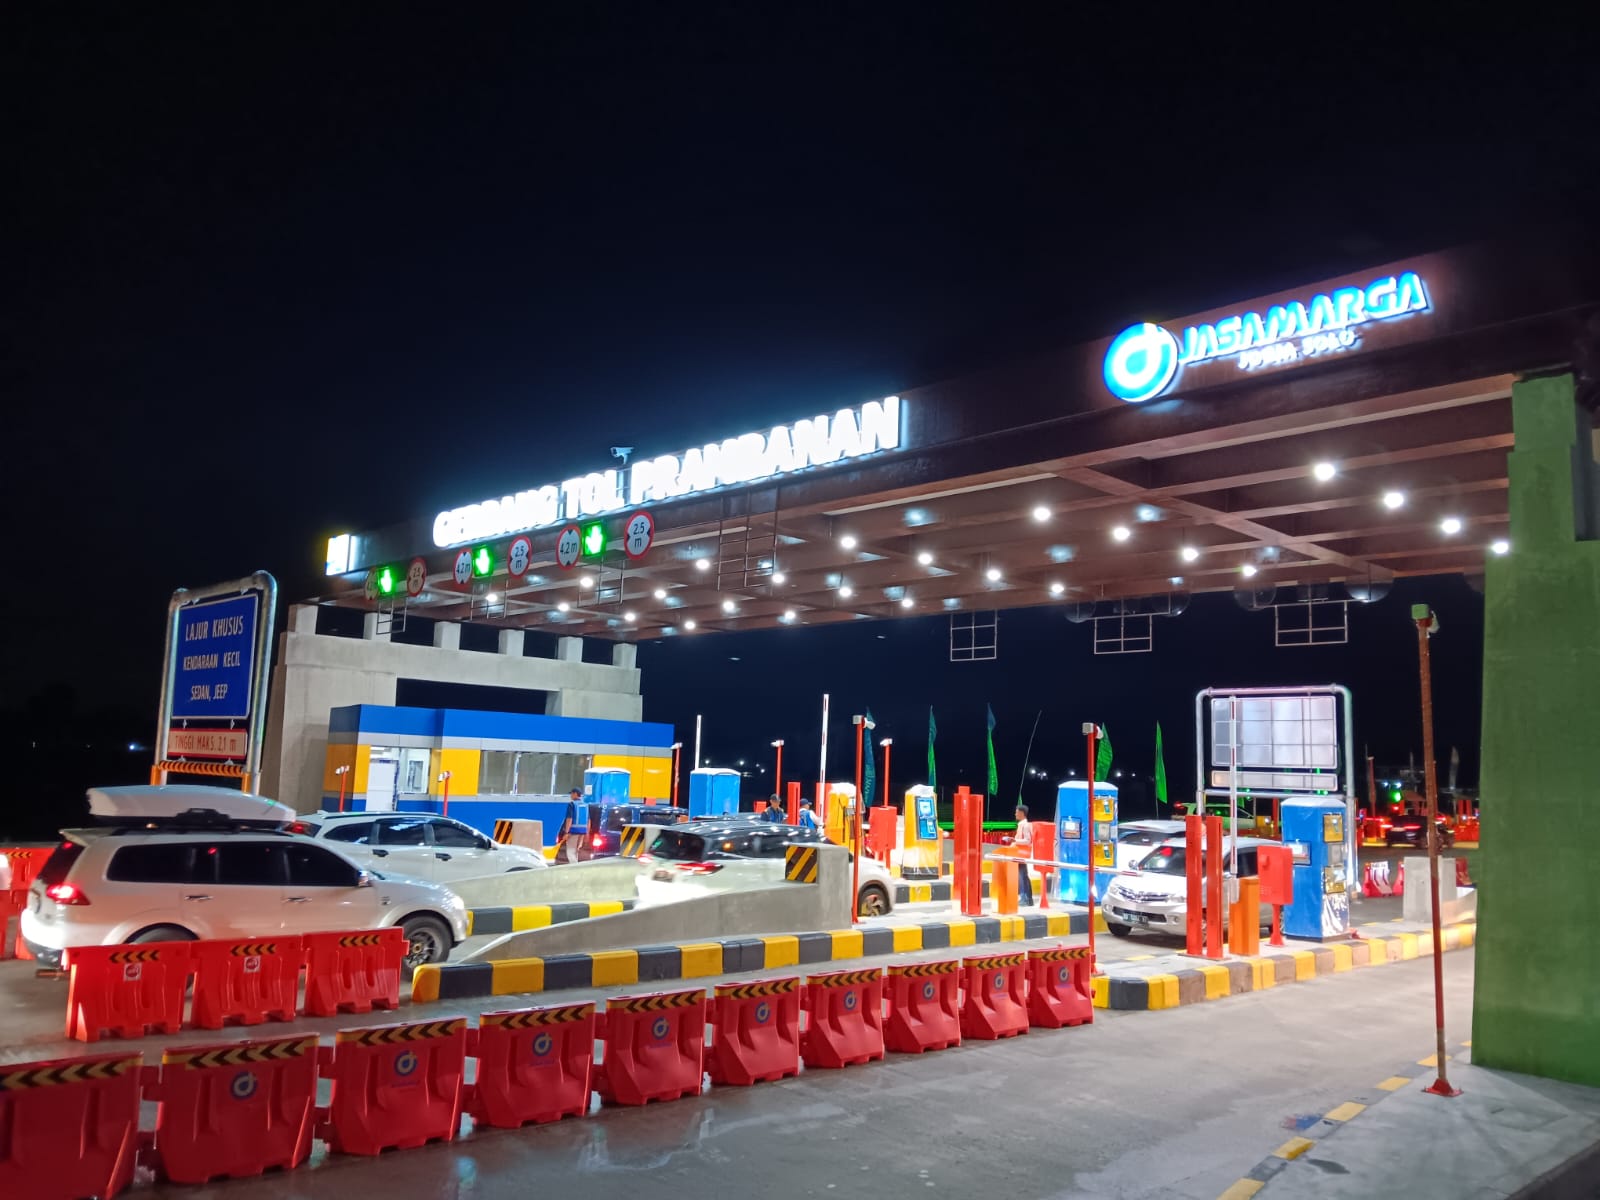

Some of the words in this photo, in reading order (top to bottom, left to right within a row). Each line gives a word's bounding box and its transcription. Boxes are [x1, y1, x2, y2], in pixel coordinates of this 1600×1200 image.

[1177, 271, 1430, 365] JASAMARGA
[561, 469, 625, 519] TOL
[633, 522, 645, 535] 2.5
[571, 543, 578, 553] m
[634, 537, 642, 548] m
[185, 621, 209, 642] LAJUR
[212, 615, 244, 638] KHUSUS
[183, 653, 218, 671] KENDARAAN
[222, 651, 241, 668] KECIL
[190, 684, 211, 702] SEDAN,
[213, 683, 228, 700] JEEP
[175, 735, 194, 750] TINGGI
